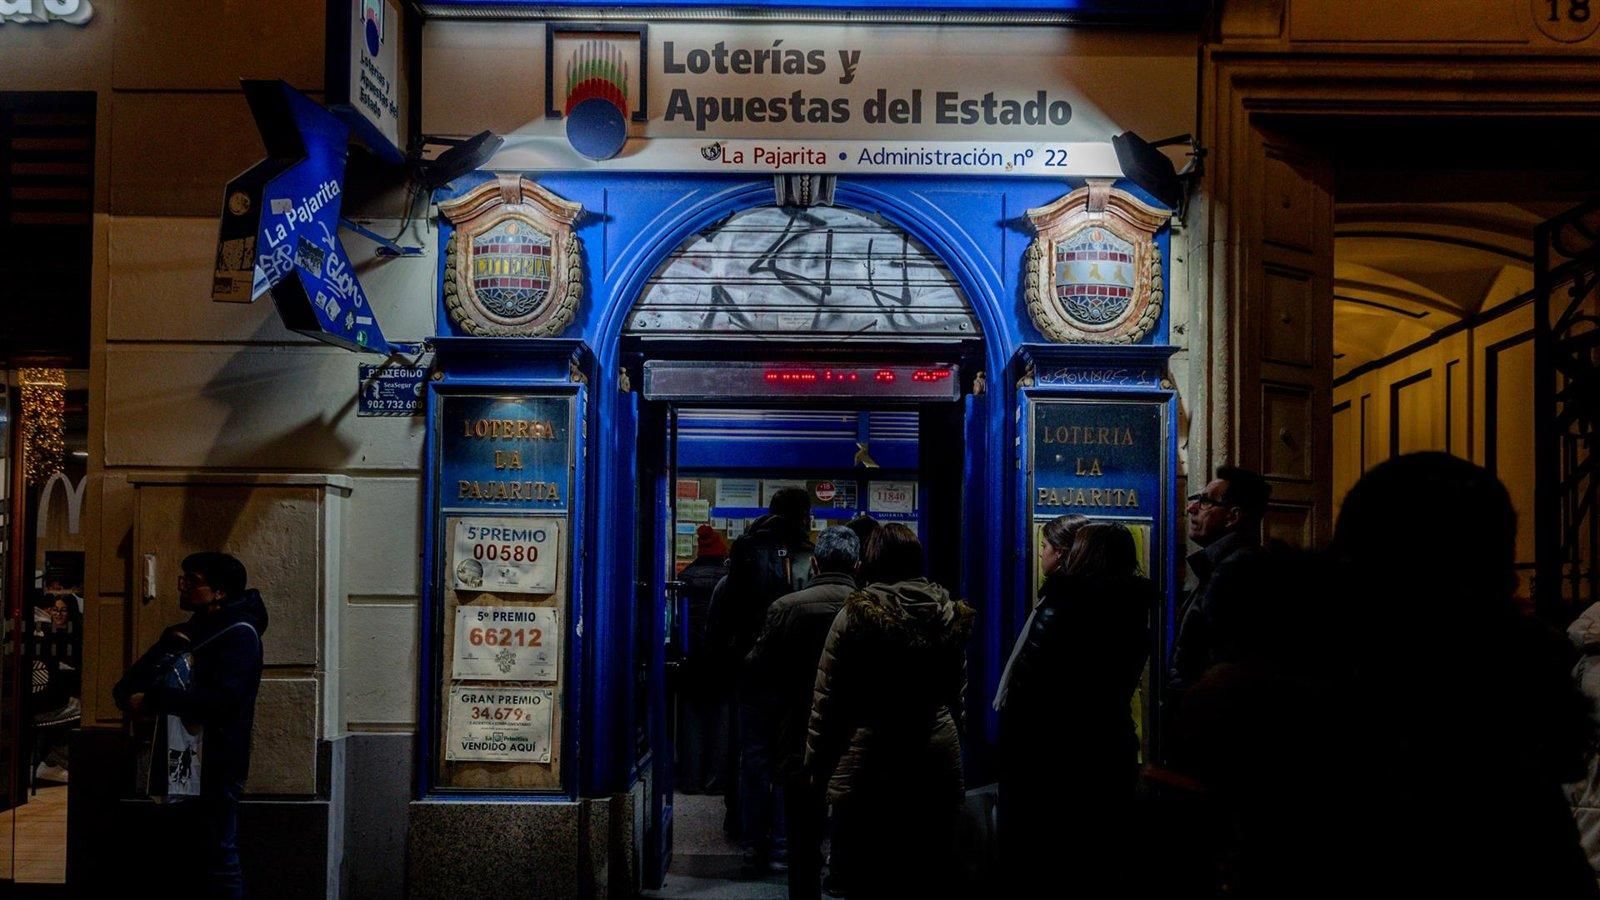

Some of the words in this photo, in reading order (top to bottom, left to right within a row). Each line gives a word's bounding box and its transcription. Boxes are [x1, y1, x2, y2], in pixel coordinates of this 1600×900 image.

[1548, 0, 1591, 22] 18
[663, 39, 827, 75] Loterías
[838, 50, 861, 84] y
[663, 88, 850, 131] Apuestas
[863, 88, 922, 125] del
[936, 90, 1073, 126] Estado
[721, 147, 744, 164] La
[754, 146, 827, 169] Pajarita
[857, 147, 1003, 166] Administración
[1013, 149, 1034, 166] nº
[1044, 149, 1069, 167] 22
[264, 223, 287, 248] La
[284, 179, 342, 231] Pajarita
[368, 368, 423, 378] POTEGIDO
[367, 400, 385, 409] 902
[386, 400, 404, 409] 732
[405, 400, 423, 409] 600
[1043, 426, 1134, 445] LOTERIA
[495, 450, 523, 469] LA
[1075, 458, 1103, 476] LA
[458, 480, 560, 500] PAJARITA
[1037, 487, 1140, 507] PAJARITA
[480, 527, 547, 543] PREMIO
[473, 543, 539, 563] 00580
[492, 611, 536, 622] PREMIO
[469, 628, 543, 647] 66212
[461, 694, 495, 704] GRAN
[498, 695, 541, 705] PREMIO
[461, 741, 507, 752] VENDIDO
[509, 741, 536, 752] AQUÍ
